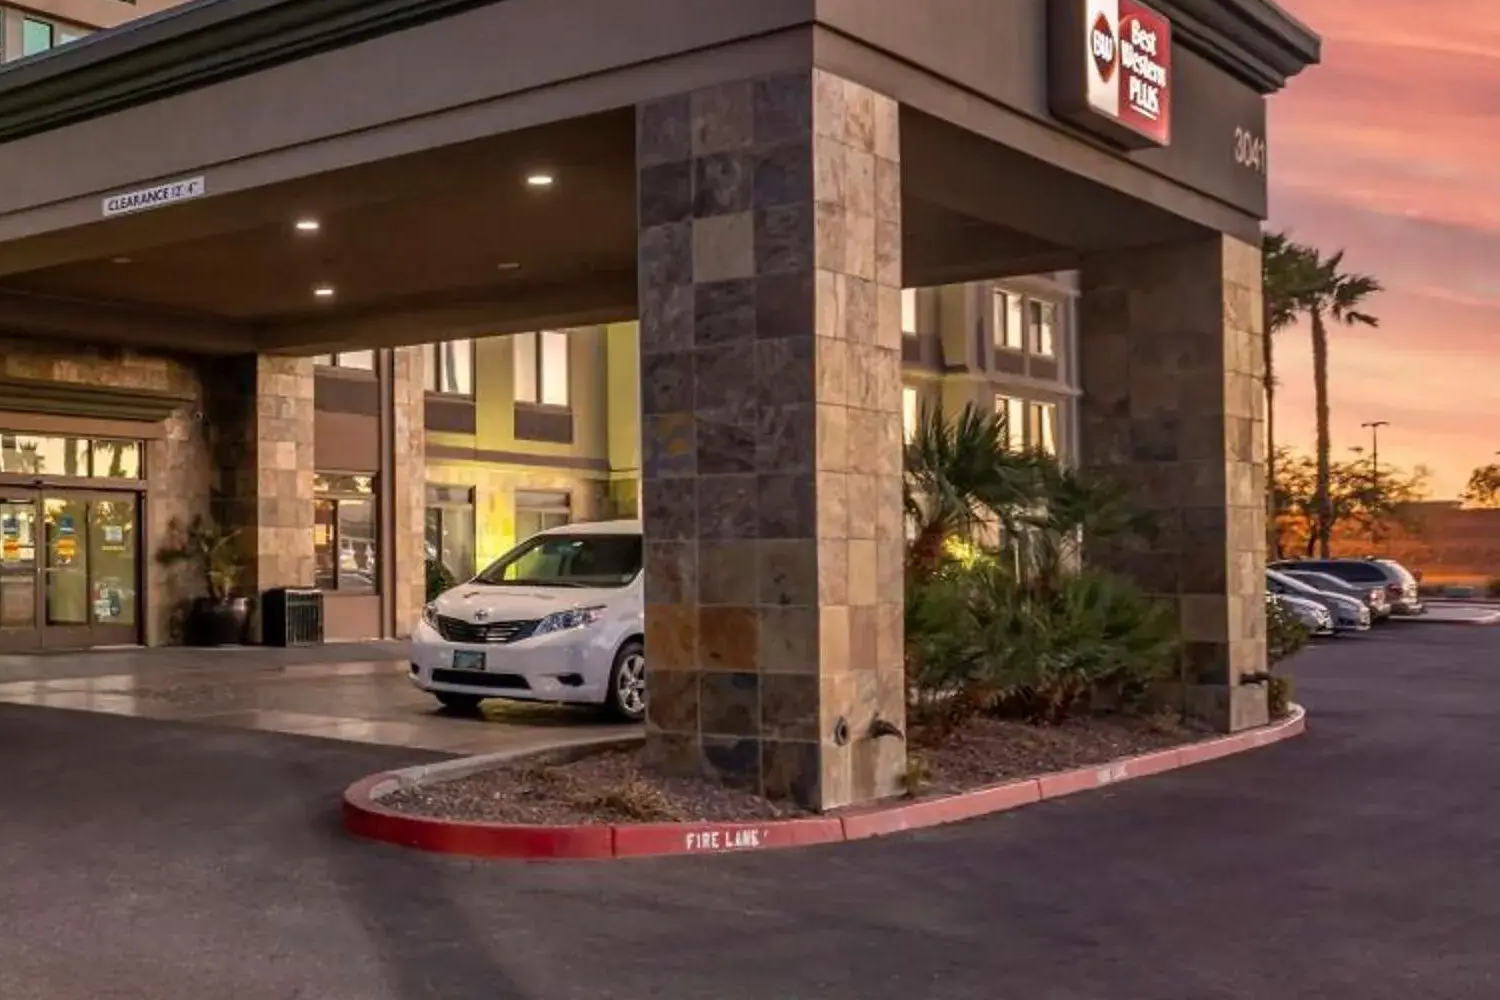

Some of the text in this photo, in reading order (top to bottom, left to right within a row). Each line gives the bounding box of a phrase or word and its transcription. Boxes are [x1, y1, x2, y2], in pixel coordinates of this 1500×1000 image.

[1093, 28, 1113, 62] BW
[1131, 19, 1157, 57] Best
[1120, 40, 1167, 88] Western
[1129, 76, 1160, 114] PLUS
[107, 187, 168, 212] CLEARANCE
[686, 828, 760, 851] FIRE LANE
